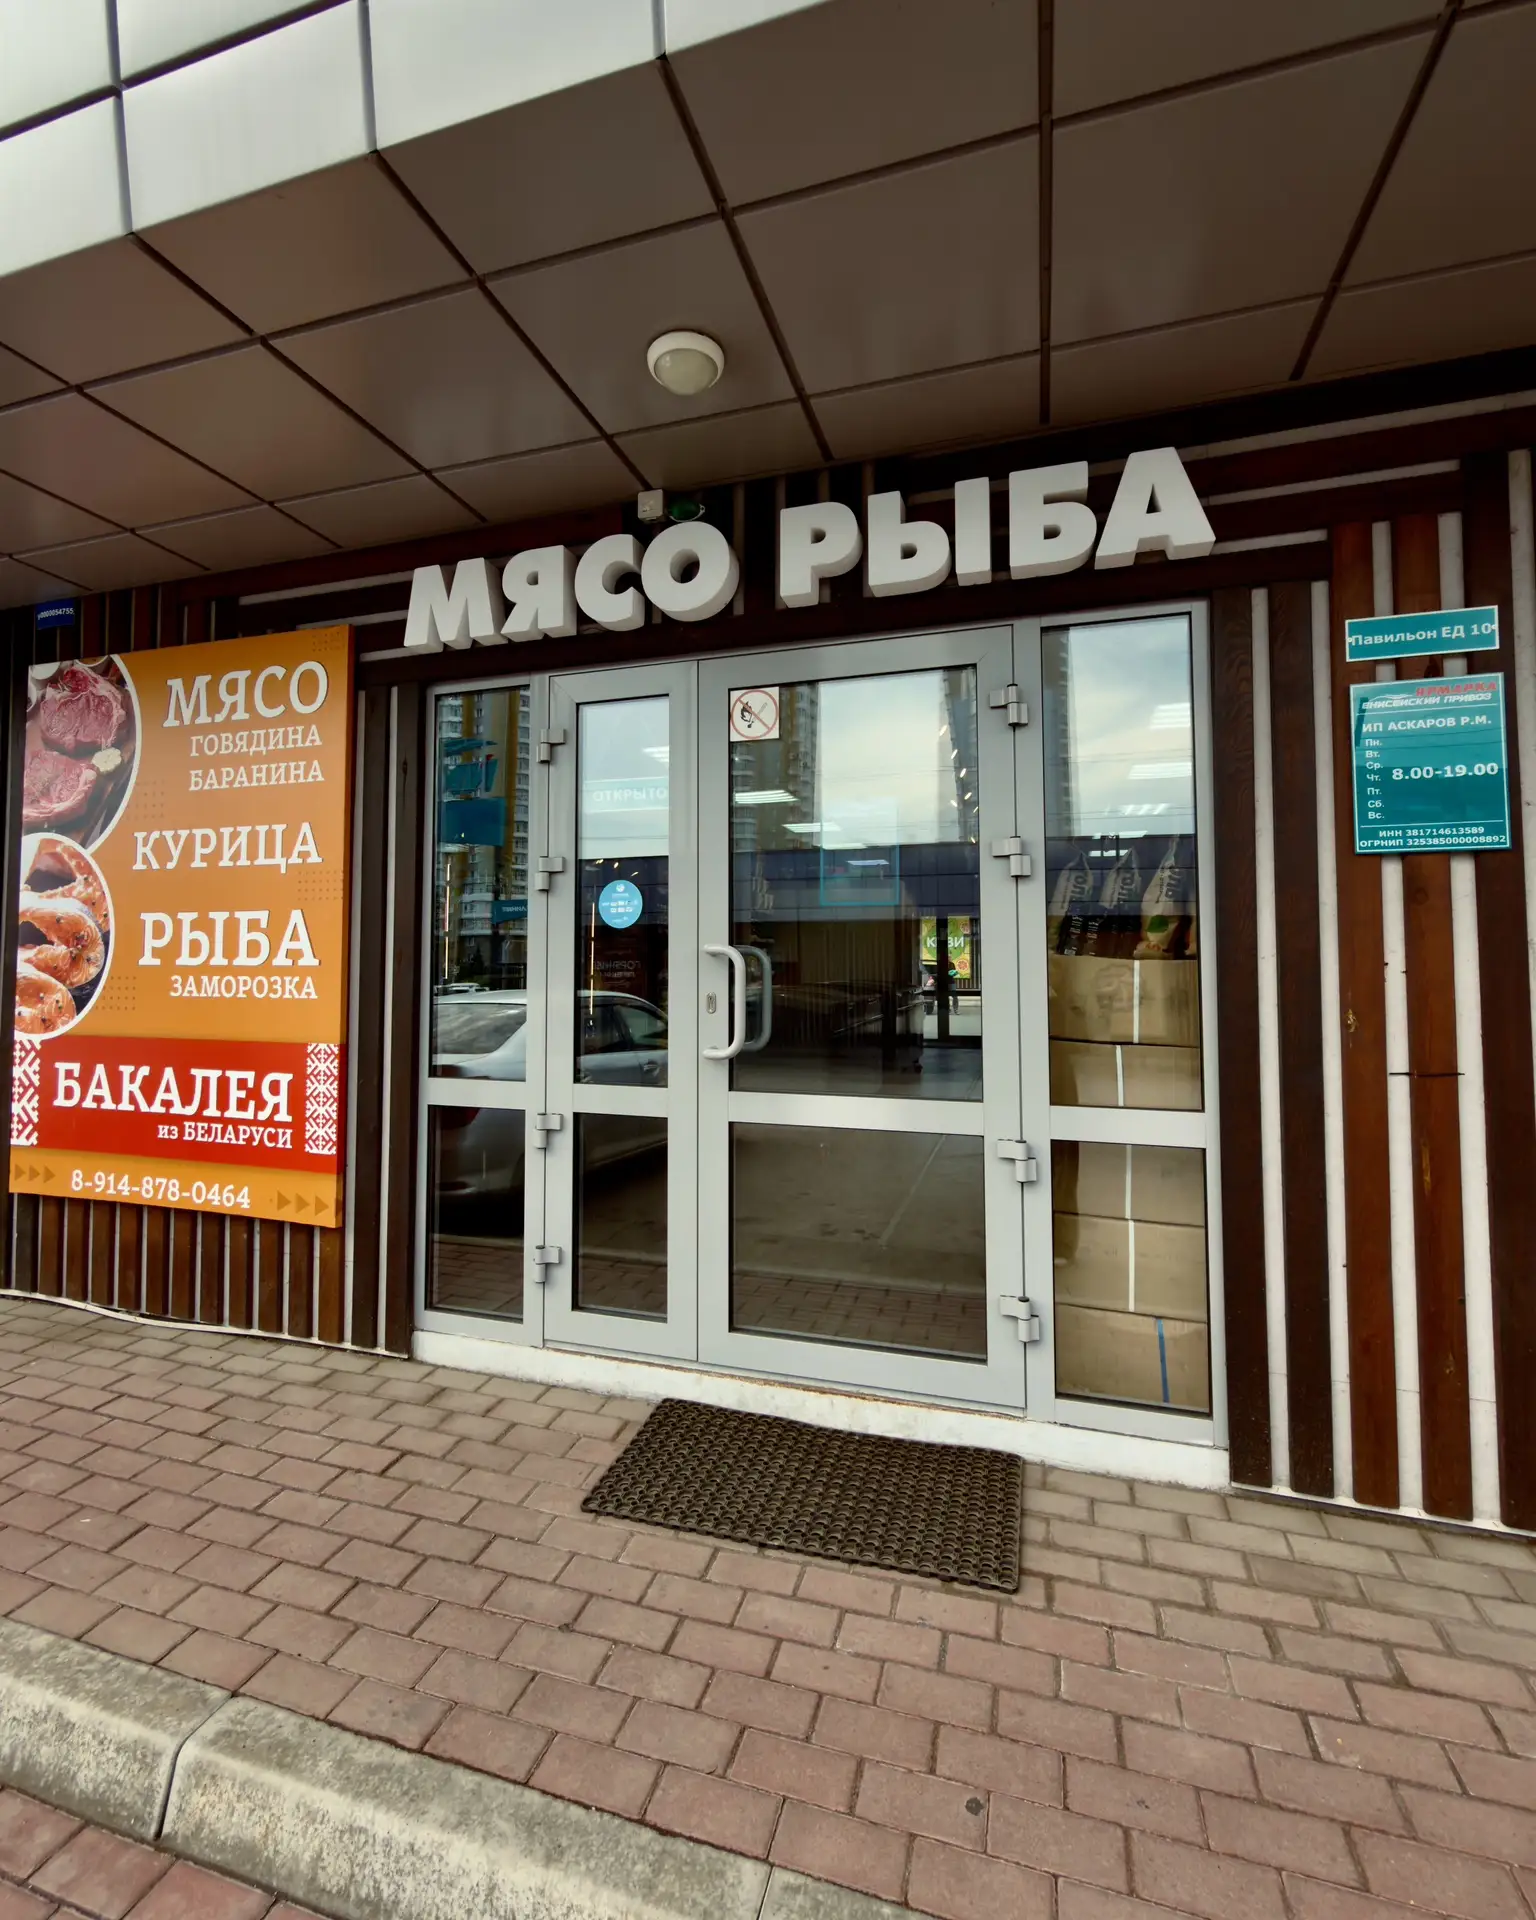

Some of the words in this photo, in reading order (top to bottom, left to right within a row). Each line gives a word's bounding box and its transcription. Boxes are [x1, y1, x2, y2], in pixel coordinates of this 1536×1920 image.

[404, 520, 739, 654] МЯСО
[778, 446, 1217, 609] РЫБА
[1353, 630, 1437, 646] Павильон
[1442, 626, 1465, 639] ЕД
[1471, 622, 1491, 636] 10
[163, 660, 330, 728] МЯСО
[1416, 682, 1497, 697] ЯРМАРКА
[1444, 692, 1491, 704] ПРИВОЗ
[1363, 722, 1383, 733] ИП
[1388, 717, 1456, 732] АСКАРОВ
[1461, 715, 1491, 726] Р.М.
[190, 724, 323, 757] ГОВЯДИНА
[1365, 738, 1383, 747] Пн.
[1365, 750, 1381, 759] Вт.
[1366, 761, 1384, 771] Ср.
[1392, 762, 1499, 780] 8.00-19.00
[189, 760, 325, 792] БАРАНИНА
[1366, 773, 1382, 783] Чт.
[593, 786, 668, 802] ОТКРЫТО
[1367, 787, 1383, 796] Пт.
[1367, 799, 1385, 809] Сб.
[1368, 811, 1385, 820] Вс.
[1379, 830, 1403, 838] ИНН
[1405, 826, 1485, 837] 381714613589
[132, 821, 323, 874] КУРИЦА
[1359, 838, 1404, 848] ОГРНИП
[138, 908, 321, 966] РЫБА
[170, 974, 318, 1000] ЗАМОРОЗКА
[53, 1061, 293, 1122] БАКАЛЕЯ
[157, 1124, 179, 1139] из
[183, 1120, 293, 1150] БЕЛАРУСИ
[71, 1169, 251, 1209] 8-914-878-0464
